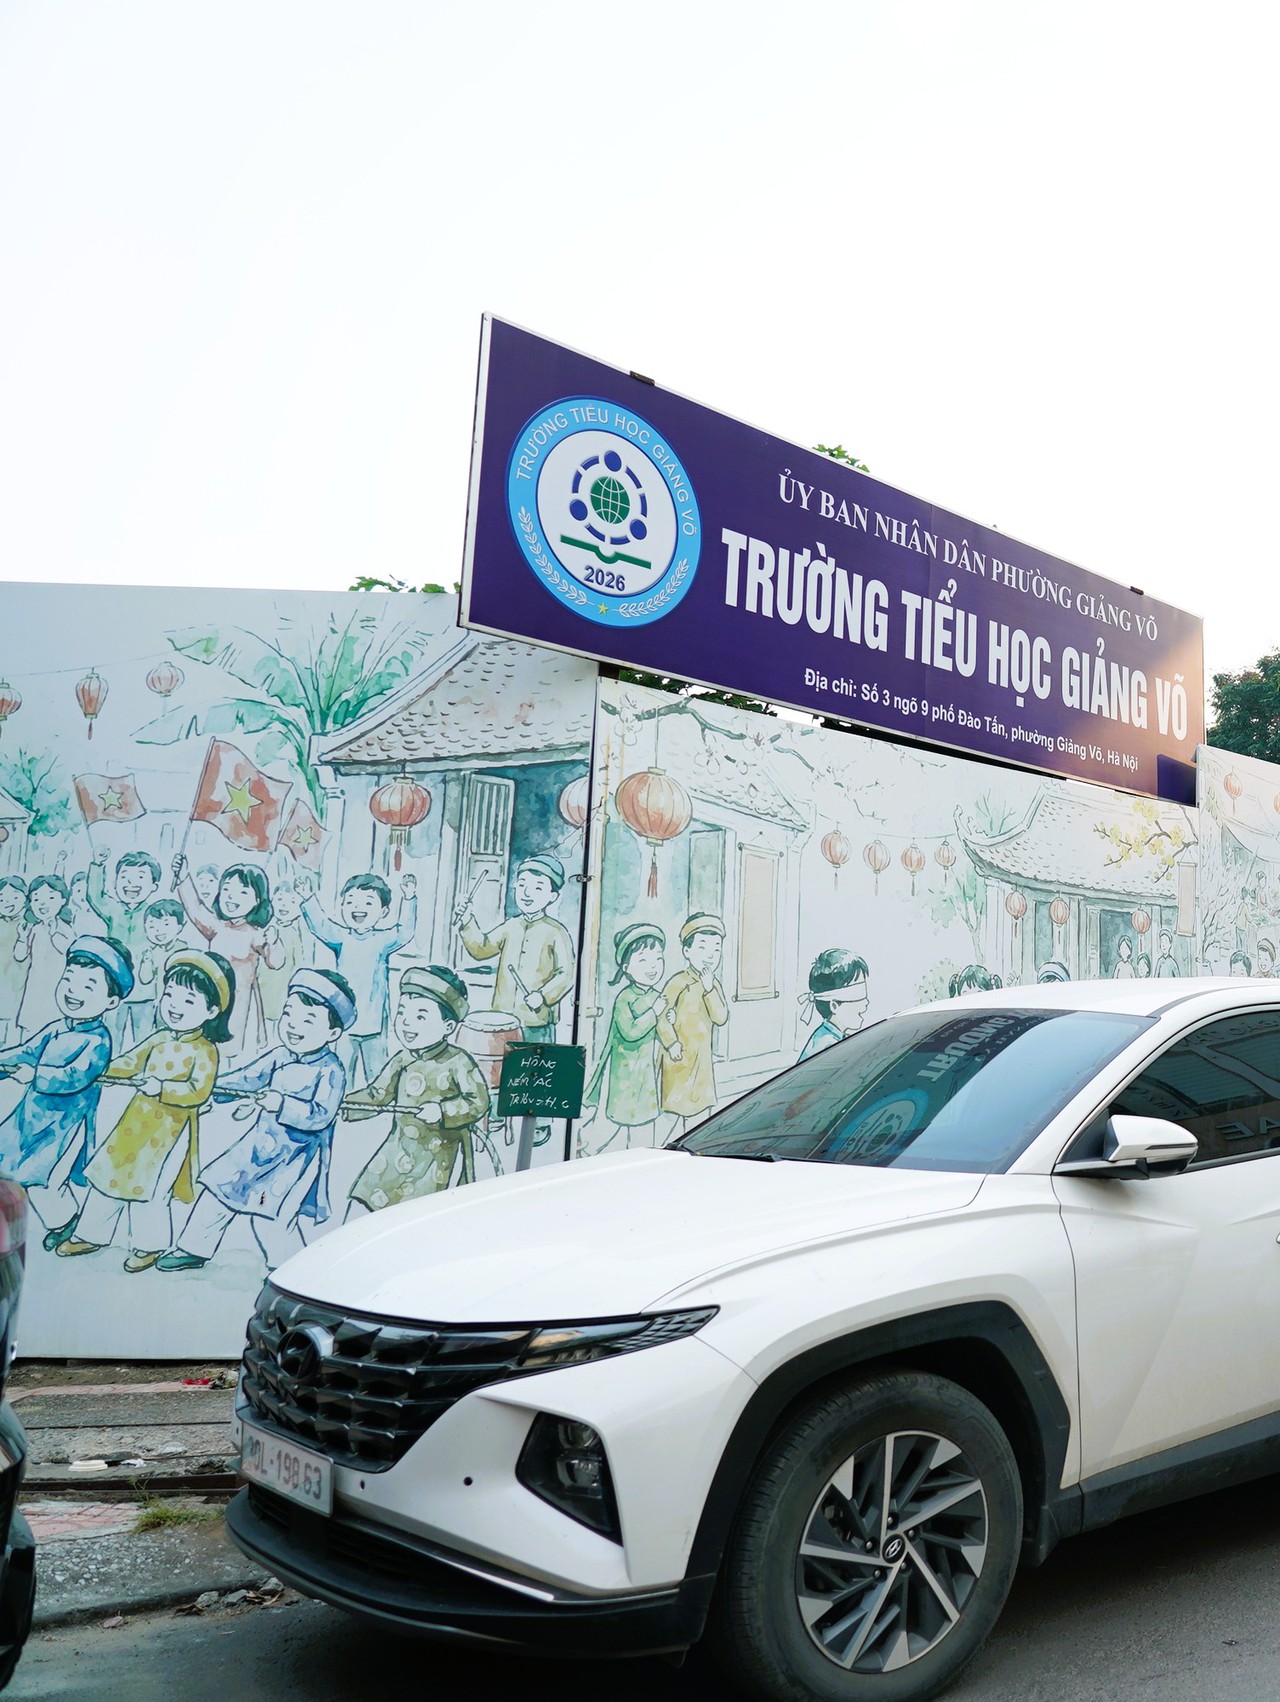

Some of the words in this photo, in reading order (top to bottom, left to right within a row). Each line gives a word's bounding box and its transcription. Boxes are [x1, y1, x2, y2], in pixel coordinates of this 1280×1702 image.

[516, 413, 568, 481] TRƯỜNG
[614, 413, 650, 445] HỌC
[652, 444, 689, 503] GIẢNG
[682, 509, 698, 537] VÕ
[584, 564, 626, 592] 2026
[778, 468, 814, 511] ỦY
[819, 489, 869, 533] BAN
[874, 511, 939, 558] NHÂN
[943, 538, 987, 578] DÂN
[991, 557, 1073, 610] PHƯỜNG
[1075, 592, 1132, 632] GIẢNG
[1135, 614, 1159, 642] VÕ
[721, 527, 889, 652] TRƯỜNG
[901, 578, 978, 678] TIỂU
[988, 619, 1052, 708] HỌC
[1061, 636, 1148, 730] GIẢNG
[1155, 673, 1188, 741] VÕ
[804, 667, 828, 692] Địa
[832, 677, 857, 698] chỉ:
[861, 682, 879, 704] Số
[882, 689, 890, 707] 3
[894, 695, 918, 716] ngõ
[921, 699, 929, 716] 9
[932, 703, 955, 723] phố
[957, 708, 981, 730] Đào
[984, 715, 1008, 739] Tấn,
[1011, 725, 1054, 752] phường
[1057, 735, 1087, 761] Giảng
[1089, 743, 1105, 764] Võ,
[1107, 749, 1120, 766] Hà
[1122, 753, 1138, 773] Nội
